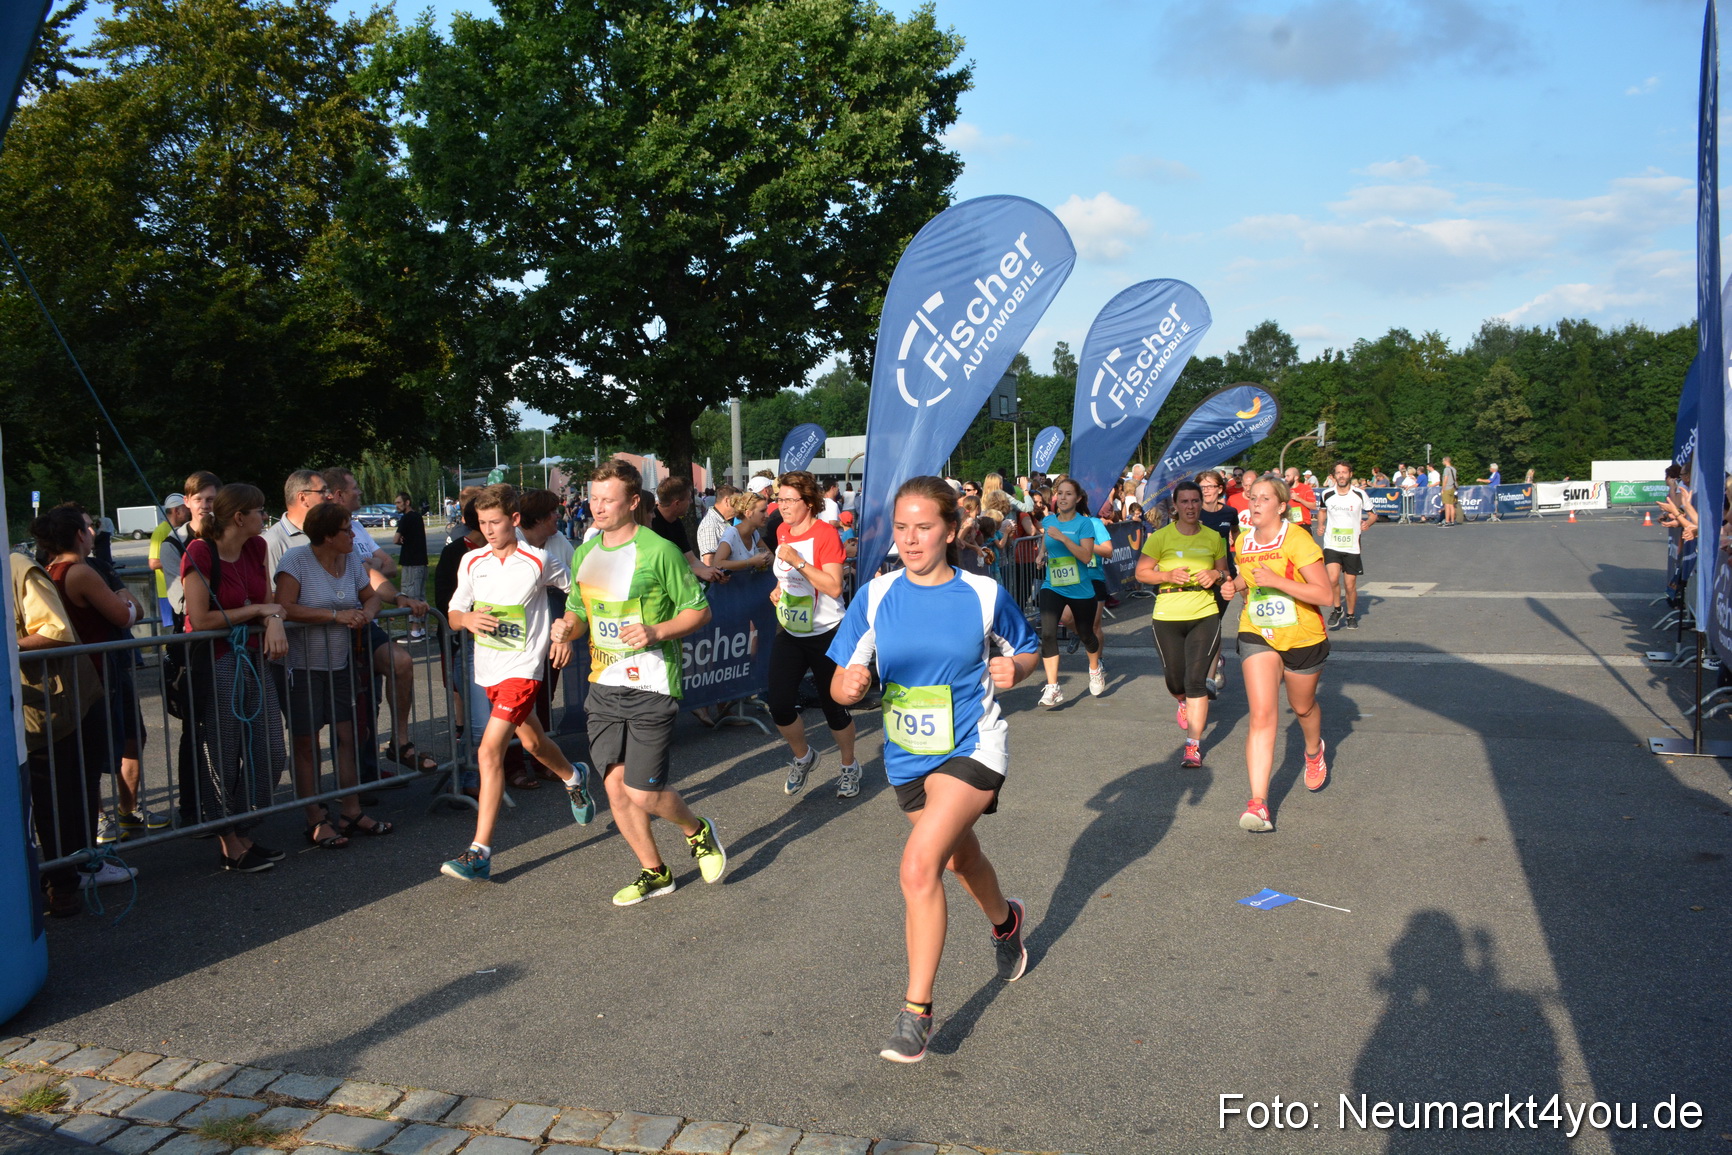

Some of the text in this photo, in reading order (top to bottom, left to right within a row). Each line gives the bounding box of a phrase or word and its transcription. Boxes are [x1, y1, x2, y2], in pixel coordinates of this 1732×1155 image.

[923, 232, 1032, 382] Fischer
[962, 260, 1044, 380] AUTOMOBILE
[1108, 302, 1182, 410] Fischer
[1134, 321, 1190, 408] AUTOMOBILE
[1164, 420, 1245, 472] Frischmann
[1216, 436, 1237, 450] Druck
[1249, 414, 1273, 432] Medien
[790, 431, 817, 467] Fischer
[1563, 488, 1590, 501] swn
[1615, 484, 1637, 496] AOK
[1333, 535, 1352, 543] 1605
[1240, 552, 1283, 564] MAX BÖGL
[1052, 567, 1075, 579] 1091
[779, 605, 808, 624] 1674
[1256, 600, 1286, 617] 859
[682, 626, 759, 670] scher
[683, 662, 751, 691] TOMOBILE
[892, 709, 936, 736] 795
